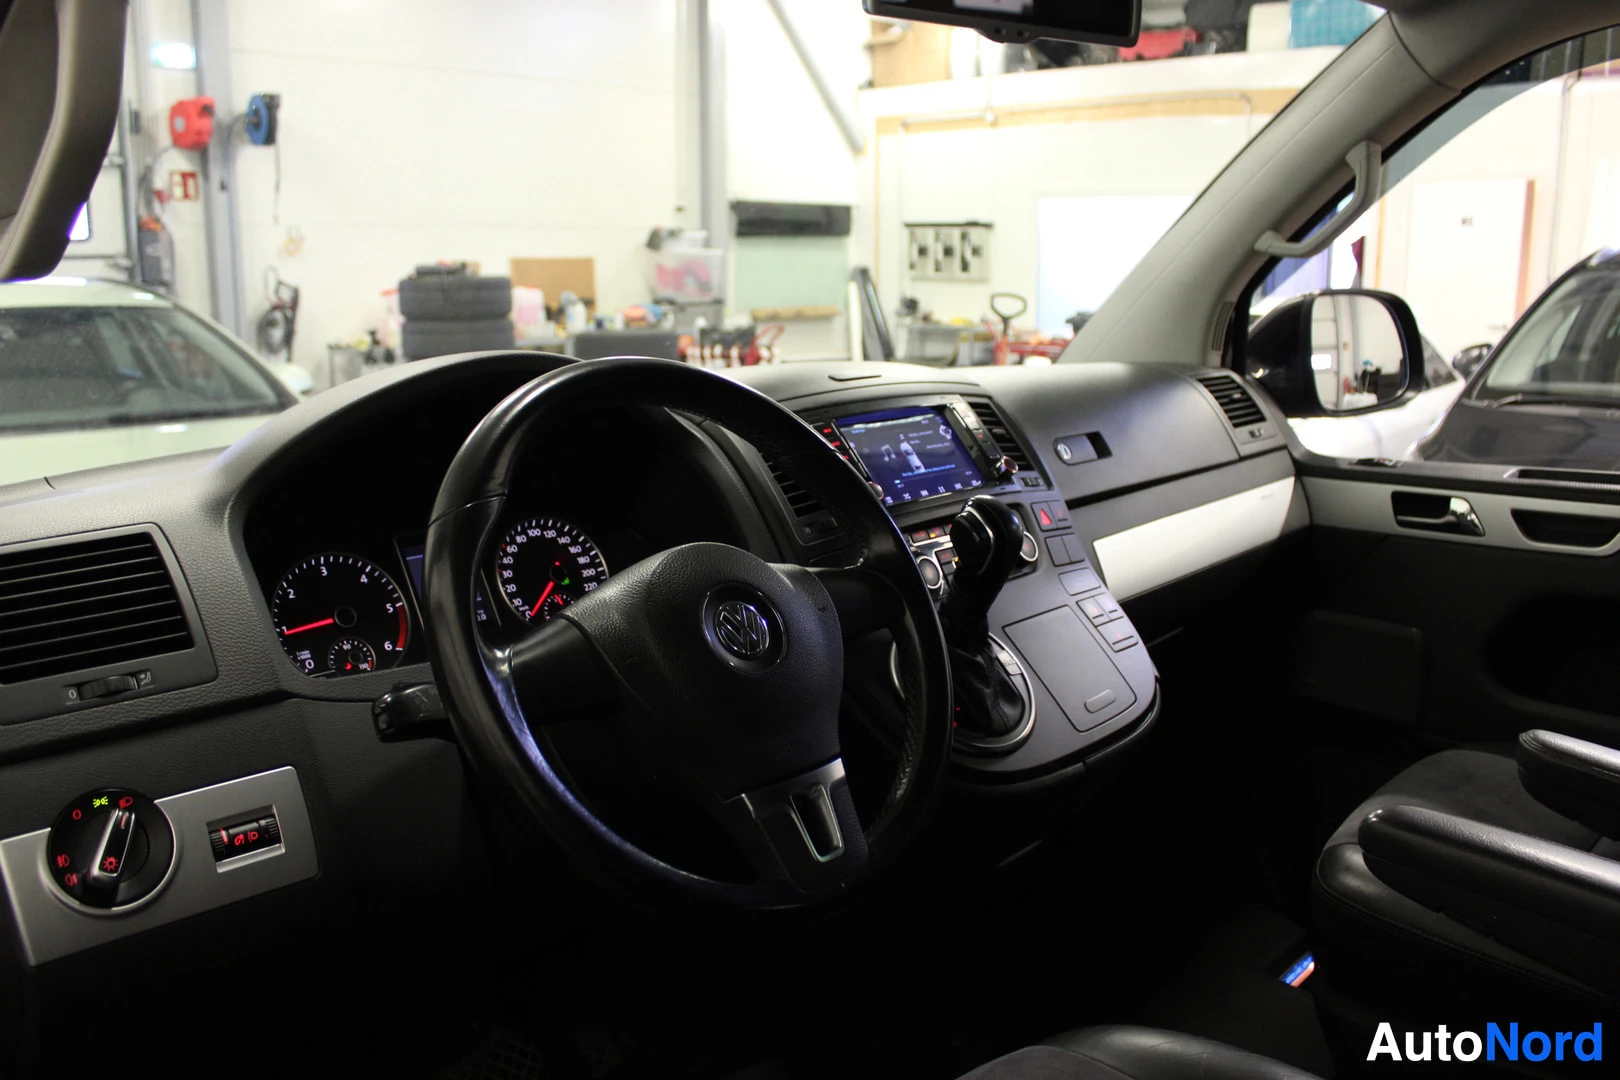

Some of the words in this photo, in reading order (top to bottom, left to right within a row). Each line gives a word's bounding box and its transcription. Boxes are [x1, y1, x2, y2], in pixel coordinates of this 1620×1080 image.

[527, 528, 541, 537] 100
[543, 529, 557, 539] 120
[515, 534, 527, 544] 80
[557, 536, 571, 545] 140
[506, 544, 518, 553] 60
[568, 545, 582, 554] 160
[502, 556, 514, 565] 40
[576, 556, 590, 565] 180
[320, 566, 328, 577] 3
[502, 569, 513, 579] 30
[581, 568, 596, 578] 200
[359, 574, 368, 584] 4
[505, 583, 517, 593] 20
[583, 581, 598, 592] 220
[287, 588, 296, 599] 2
[512, 598, 523, 607] 10
[385, 603, 394, 614] 5
[384, 640, 393, 651] 6
[305, 658, 315, 670] 0
[68, 689, 77, 699] 0
